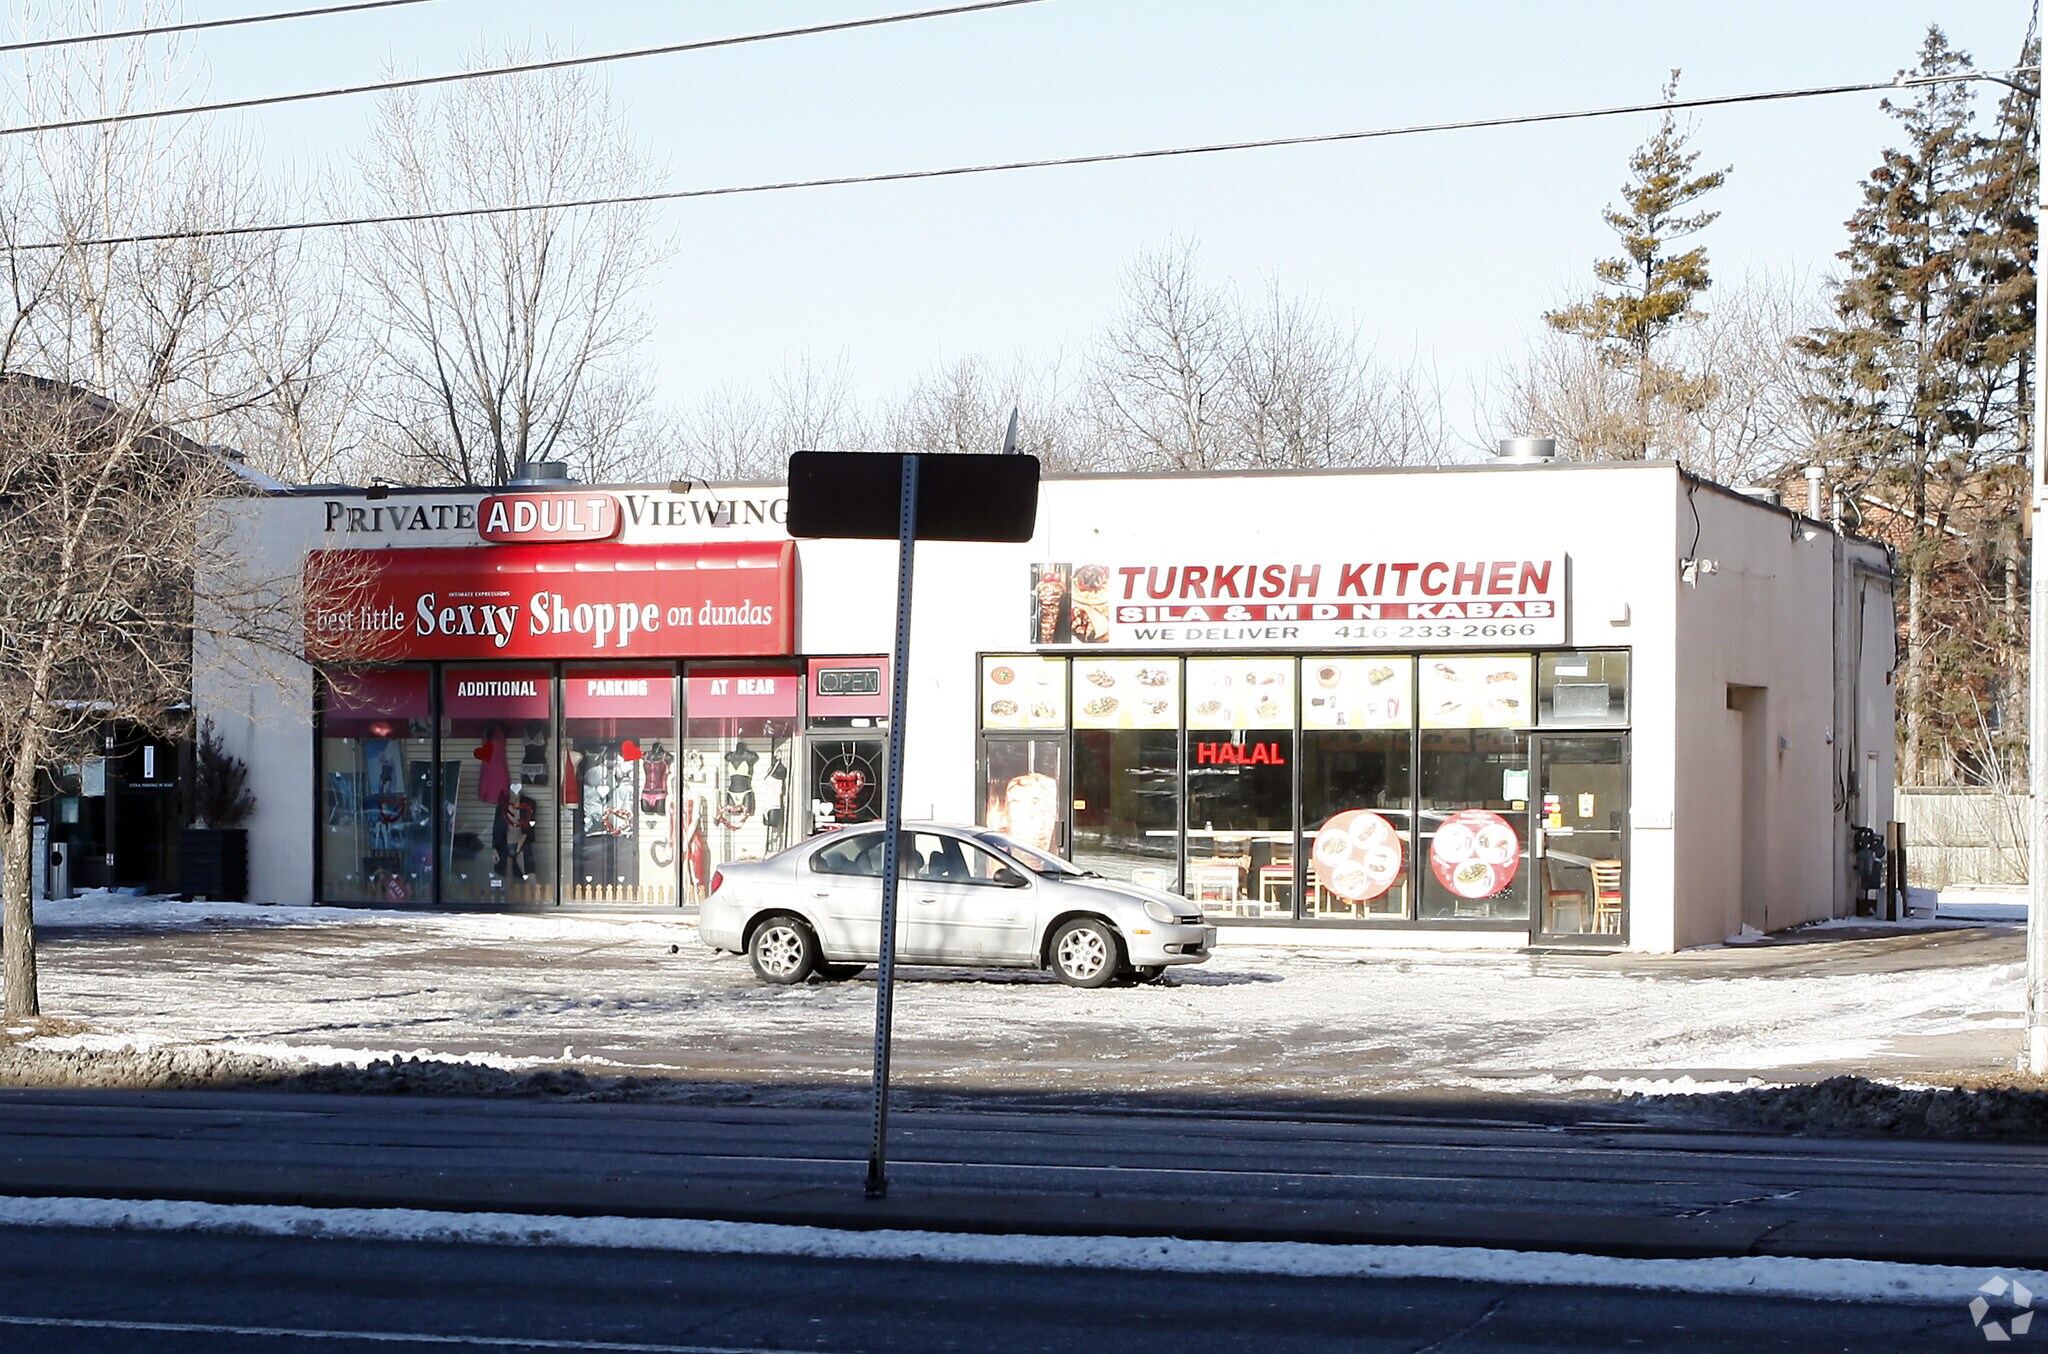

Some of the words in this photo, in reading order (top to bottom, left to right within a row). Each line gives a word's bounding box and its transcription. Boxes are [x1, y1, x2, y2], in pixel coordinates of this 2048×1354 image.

[324, 501, 475, 533] PRIVATE
[486, 499, 607, 533] ADULT
[624, 495, 788, 526] VIEWING
[1118, 564, 1321, 600] TURKISH
[1337, 560, 1552, 597] KITCHEN
[317, 607, 355, 632] best
[361, 605, 405, 631] little
[416, 592, 520, 648] Sexxy
[529, 591, 661, 649] Shoppe
[667, 605, 693, 627] on
[698, 599, 773, 626] dundas
[1118, 606, 1211, 623] SILA
[1407, 601, 1553, 619] KABAB
[1135, 628, 1175, 641] WE
[1185, 626, 1299, 640] DELIVER
[1334, 623, 1536, 639] 416-233-2666
[457, 680, 538, 697] ADDITIONAL
[587, 679, 648, 697] PARKING
[710, 679, 729, 696] AT
[736, 678, 776, 695] REAR
[821, 672, 878, 692] OPEN
[1197, 742, 1285, 765] HALAL
